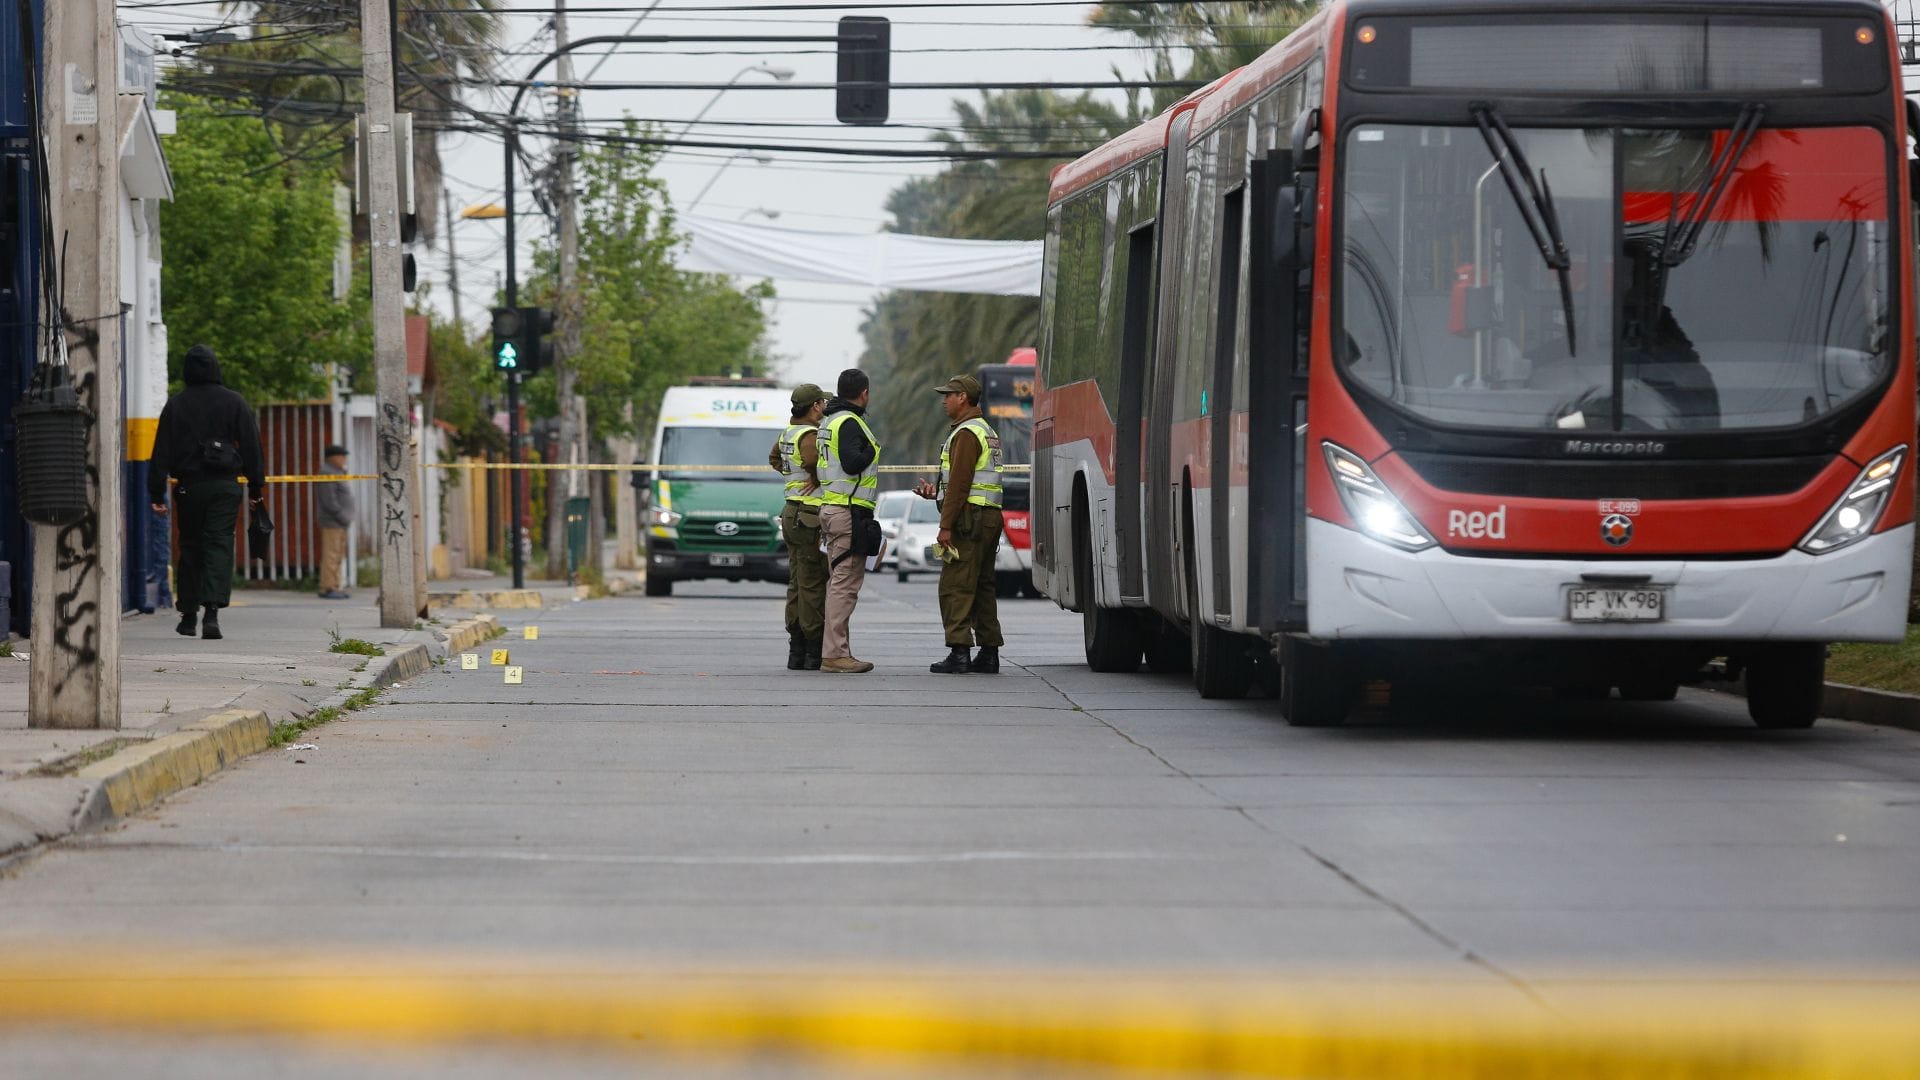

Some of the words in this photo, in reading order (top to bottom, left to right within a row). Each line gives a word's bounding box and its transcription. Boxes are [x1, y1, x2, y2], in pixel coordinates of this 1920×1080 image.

[711, 399, 760, 412] SIAT
[1565, 440, 1665, 454] Marcopolo
[1602, 501, 1638, 512] EC-099
[1448, 504, 1506, 539] Red
